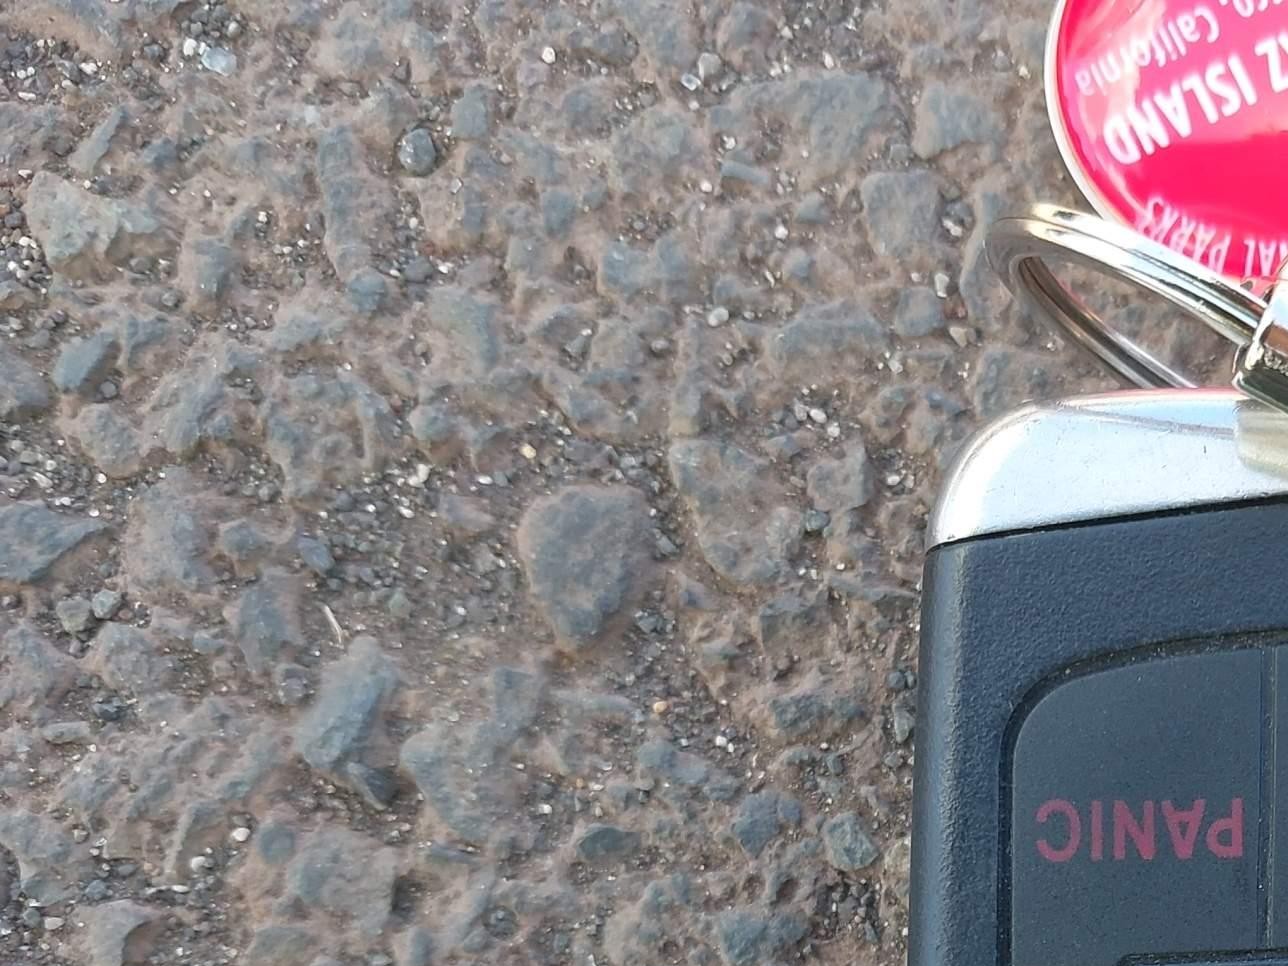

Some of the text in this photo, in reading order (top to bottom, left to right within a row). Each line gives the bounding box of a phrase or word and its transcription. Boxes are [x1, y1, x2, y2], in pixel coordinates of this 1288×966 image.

[1074, 5, 1220, 96] California
[1102, 53, 1258, 165] ISLAND
[1134, 196, 1232, 276] PARKS
[1036, 798, 1243, 862] PANIC
